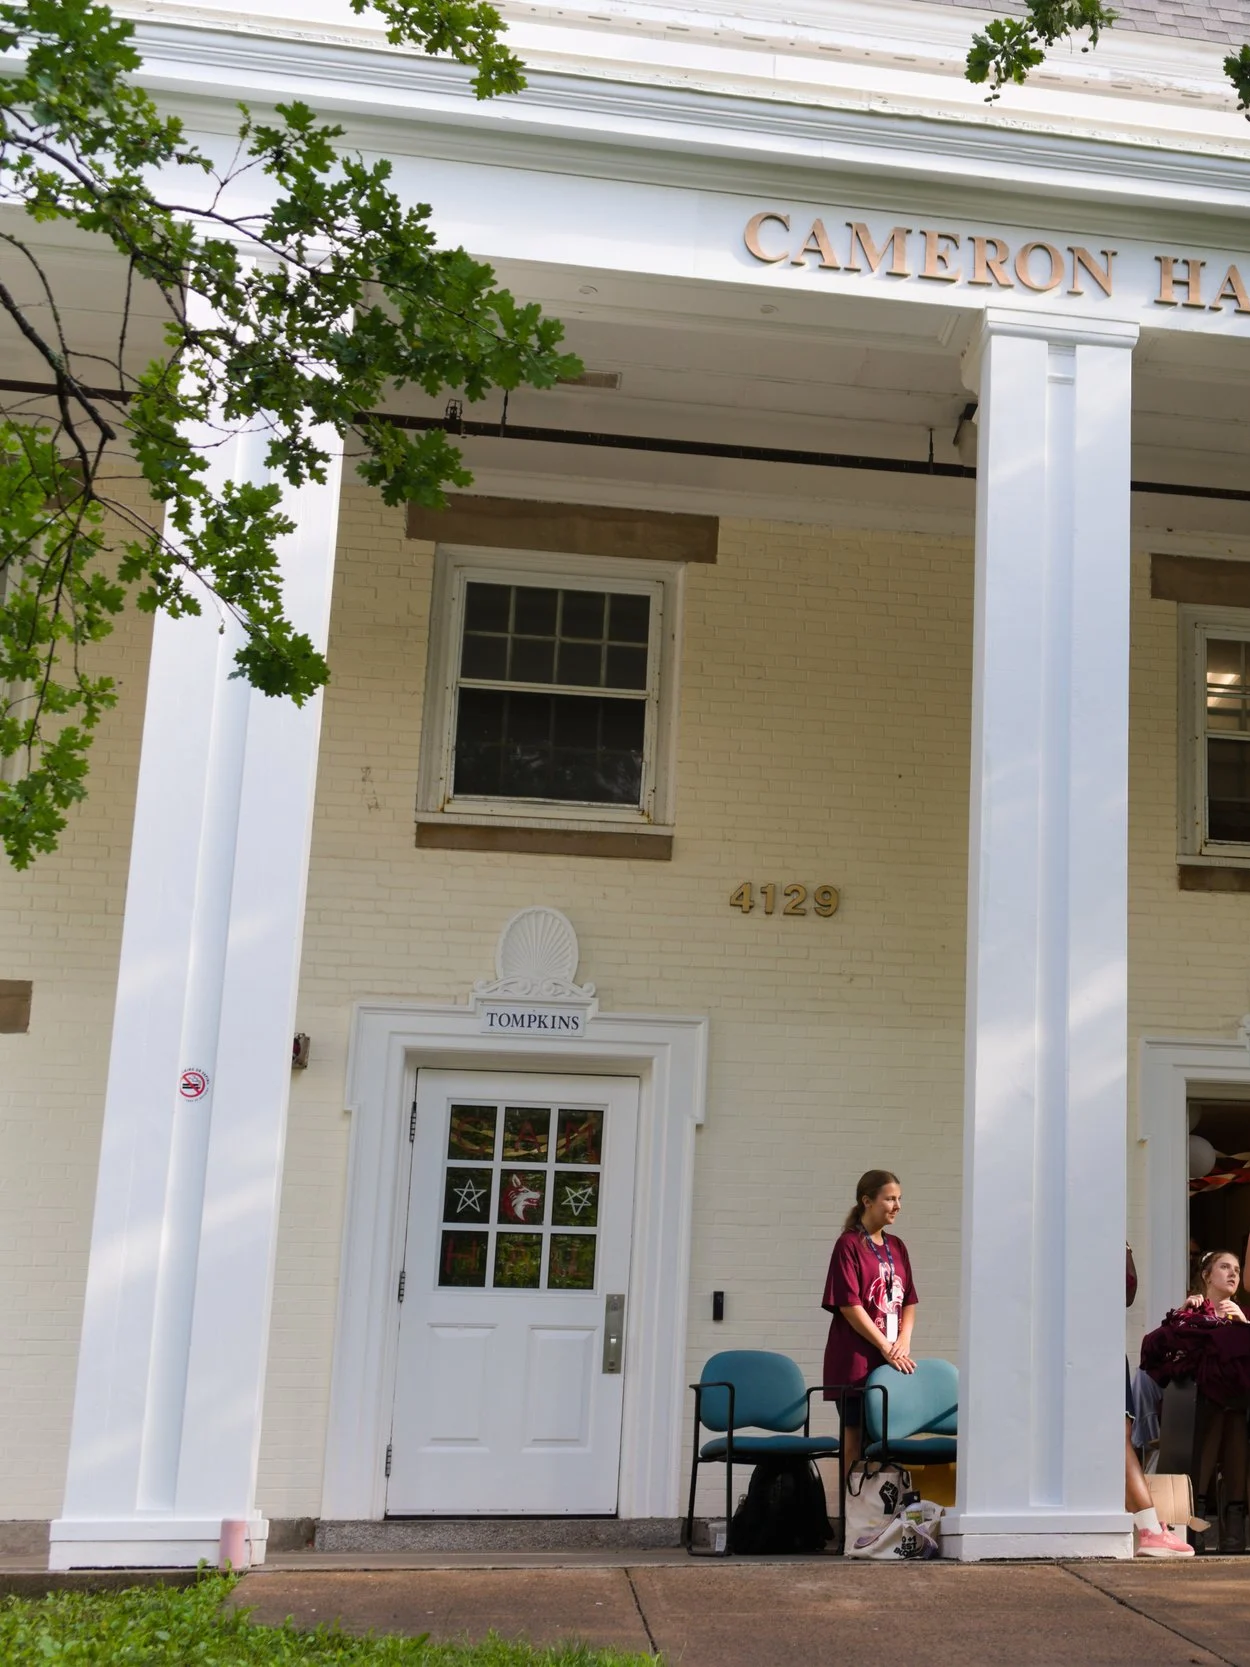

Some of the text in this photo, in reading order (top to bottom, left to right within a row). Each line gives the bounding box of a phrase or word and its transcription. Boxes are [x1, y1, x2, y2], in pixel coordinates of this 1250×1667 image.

[742, 210, 1119, 298] CAMERON
[729, 882, 841, 917] 4129
[486, 1011, 580, 1031] TOMPKINS
[456, 1116, 595, 1154] CAM
